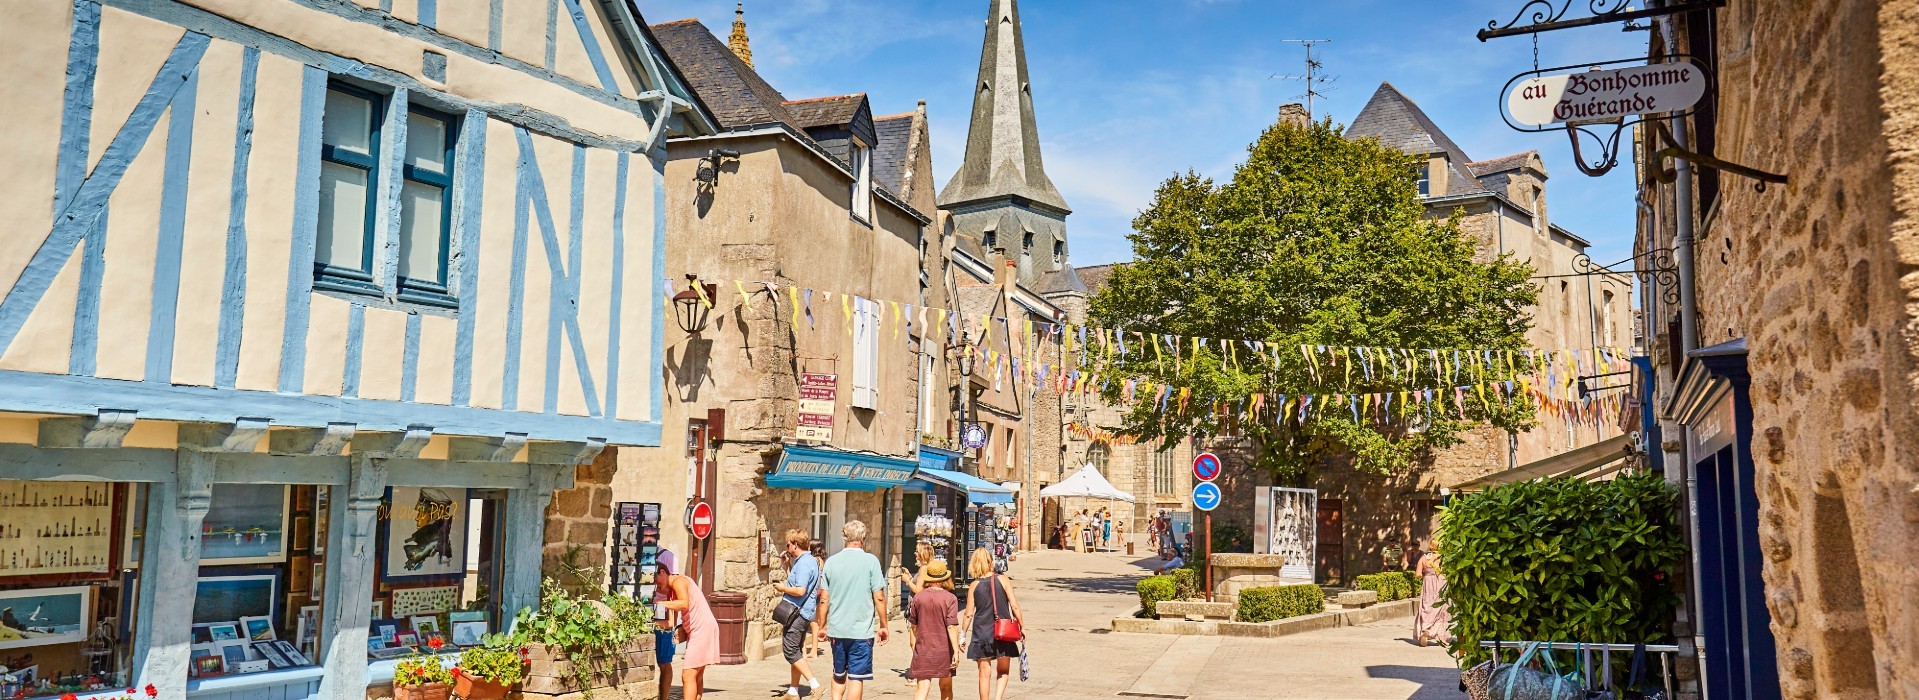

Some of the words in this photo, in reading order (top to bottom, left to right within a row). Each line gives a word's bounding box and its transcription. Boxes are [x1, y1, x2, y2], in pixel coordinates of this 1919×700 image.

[1522, 84, 1547, 100] au
[1568, 67, 1690, 94] Bonhomme
[1553, 92, 1656, 120] Guérande
[784, 461, 819, 473] PRODUITS
[818, 463, 829, 475] DE
[827, 463, 837, 475] LA
[836, 464, 853, 476] MER
[861, 466, 885, 479] VENTE
[881, 469, 911, 482] DIRECTE
